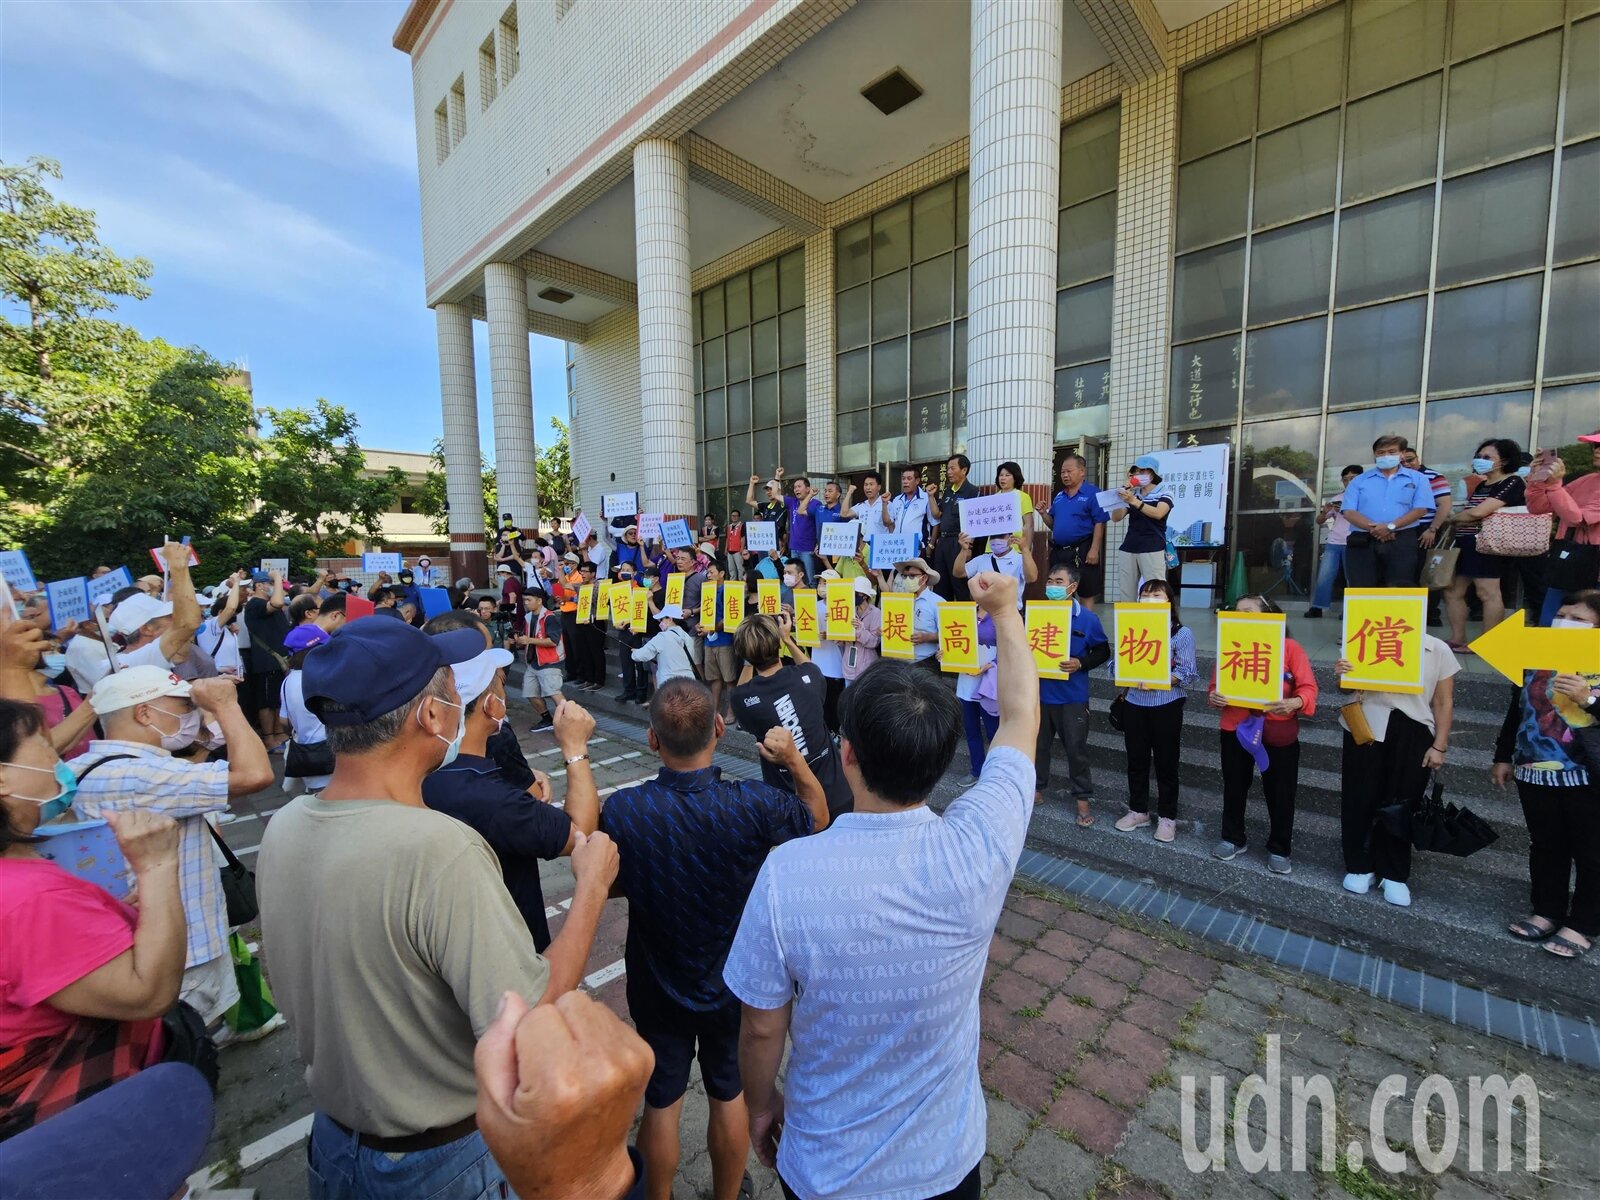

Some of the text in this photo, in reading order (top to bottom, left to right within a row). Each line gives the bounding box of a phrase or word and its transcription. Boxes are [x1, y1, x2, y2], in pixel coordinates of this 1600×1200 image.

[1189, 355, 1204, 420] 大道之行也
[1160, 470, 1215, 482] 園航空城安置住宅
[1194, 482, 1213, 498] 會場
[613, 595, 630, 614] 安
[667, 587, 681, 605] 住
[702, 596, 714, 617] 宅
[727, 596, 739, 620] 售
[760, 595, 776, 614] 價
[633, 601, 645, 620] 置
[797, 607, 815, 631] 全
[830, 598, 849, 623] 面
[883, 611, 911, 643] 提
[944, 620, 970, 655] 高
[1029, 622, 1064, 659] 建
[1119, 627, 1162, 666] 物
[1347, 616, 1414, 668] 償
[1220, 640, 1272, 685] 補
[851, 986, 919, 1005] CUMAR
